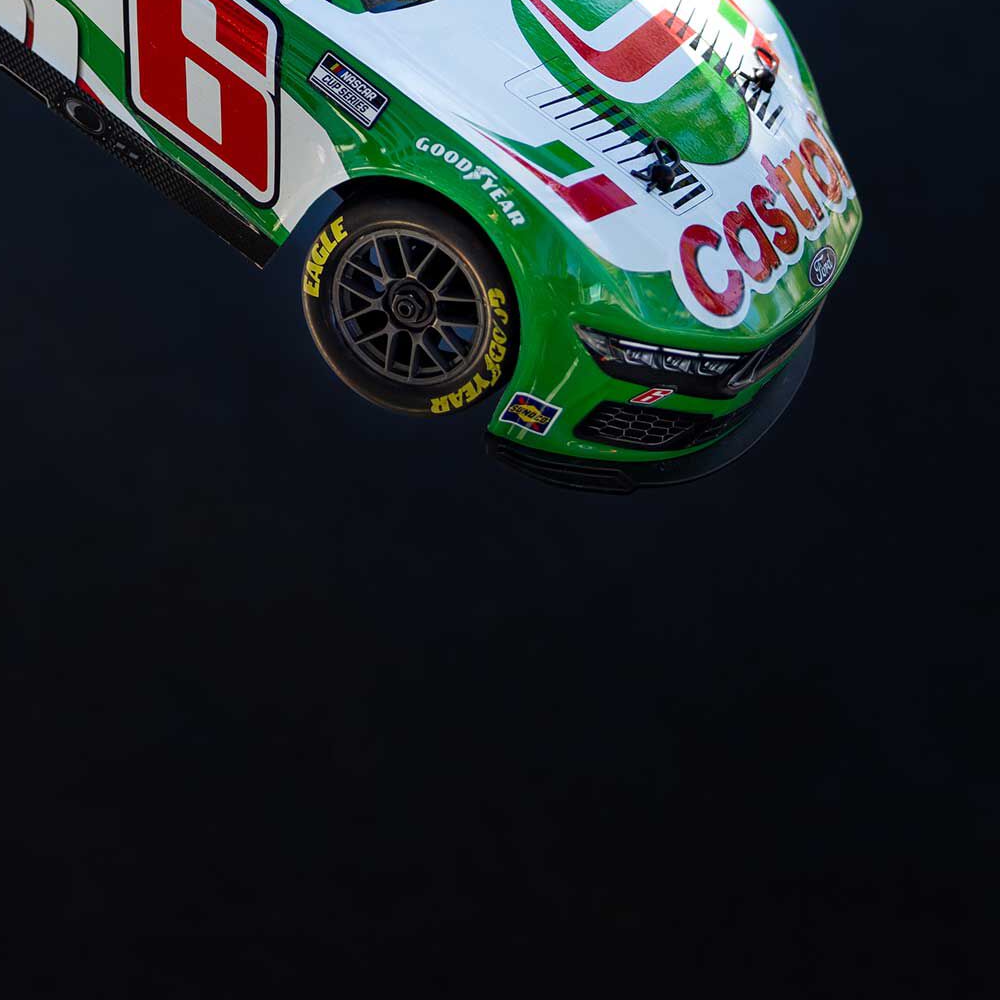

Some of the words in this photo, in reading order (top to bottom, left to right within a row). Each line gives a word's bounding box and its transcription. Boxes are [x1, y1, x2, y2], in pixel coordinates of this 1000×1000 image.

[321, 74, 341, 91] CUP
[338, 86, 369, 113] SERIES
[340, 70, 378, 102] NASCAR
[415, 137, 526, 227] GOODYEAR
[679, 109, 852, 318] Castrol
[303, 215, 348, 298] EAGLE
[812, 250, 835, 283] Ford
[430, 287, 509, 415] GOODYEAR
[507, 403, 552, 425] SUNOCO
[629, 387, 674, 405] 6
